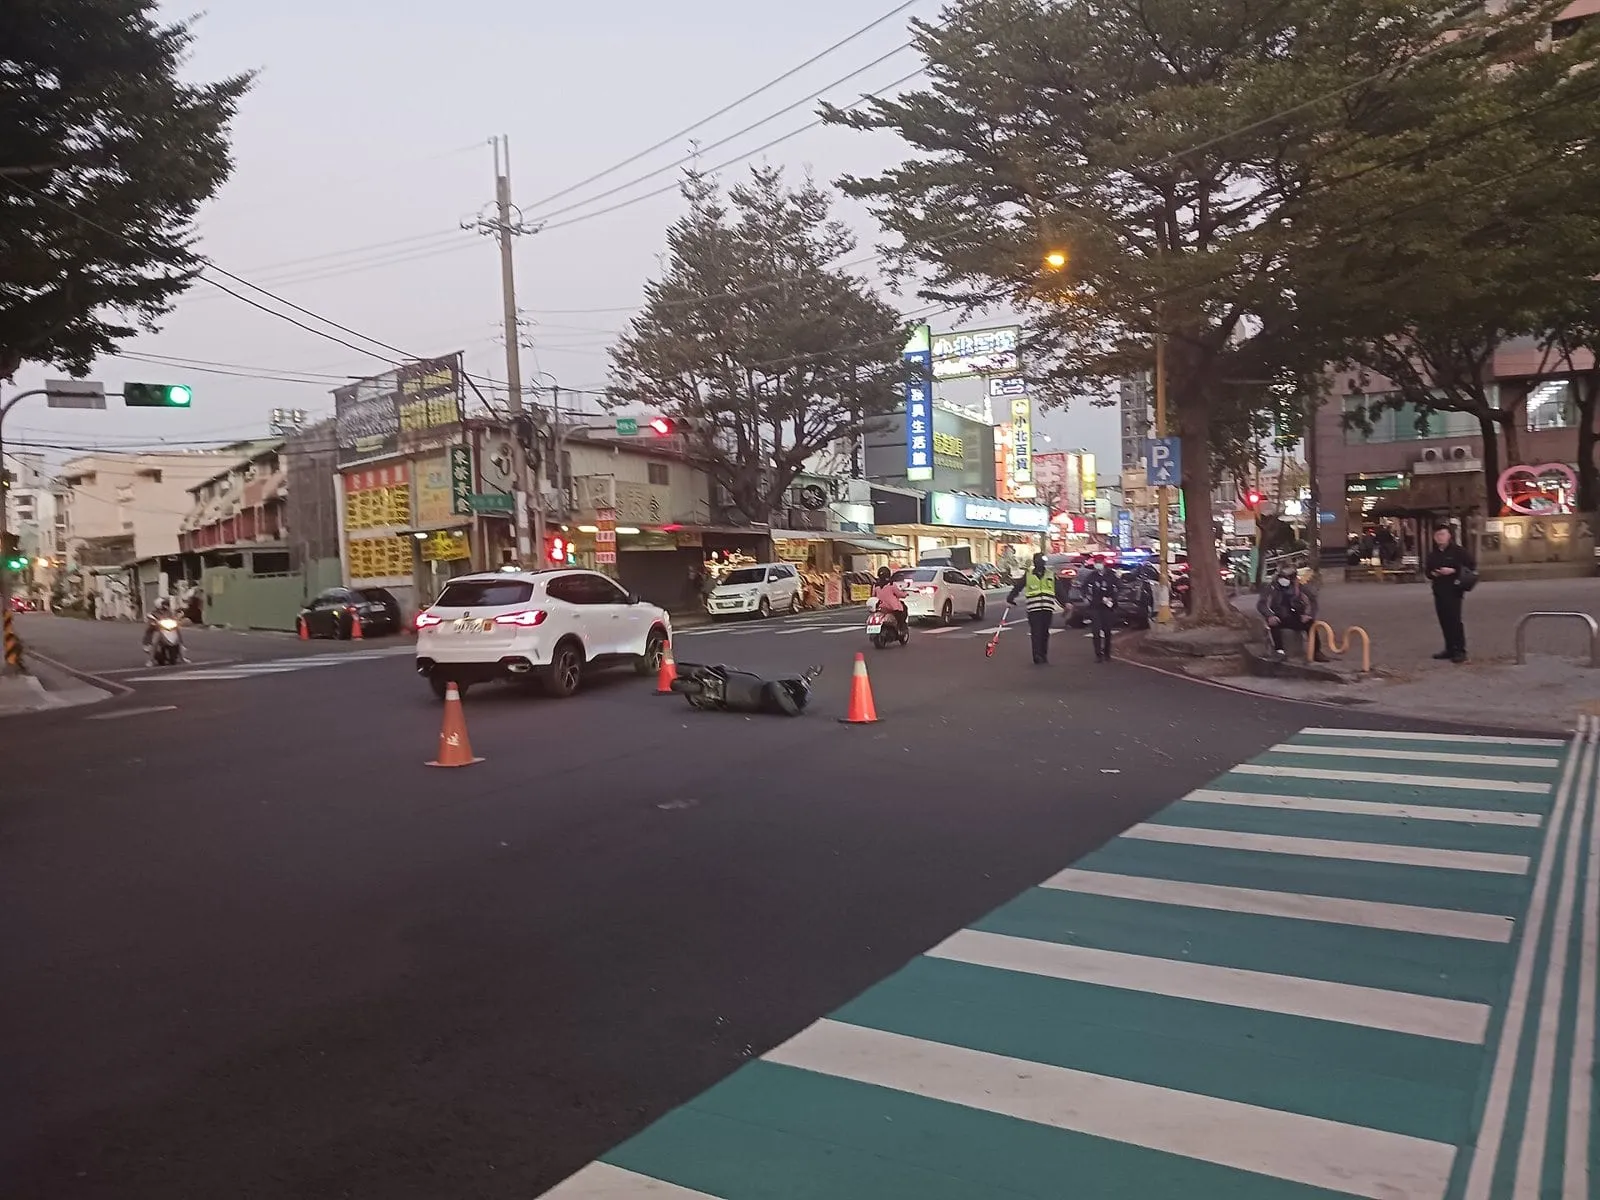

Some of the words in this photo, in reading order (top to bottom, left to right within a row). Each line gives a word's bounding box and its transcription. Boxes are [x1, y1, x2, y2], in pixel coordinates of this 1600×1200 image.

[1014, 415, 1030, 471] 小北百貨
[1152, 445, 1170, 468] P
